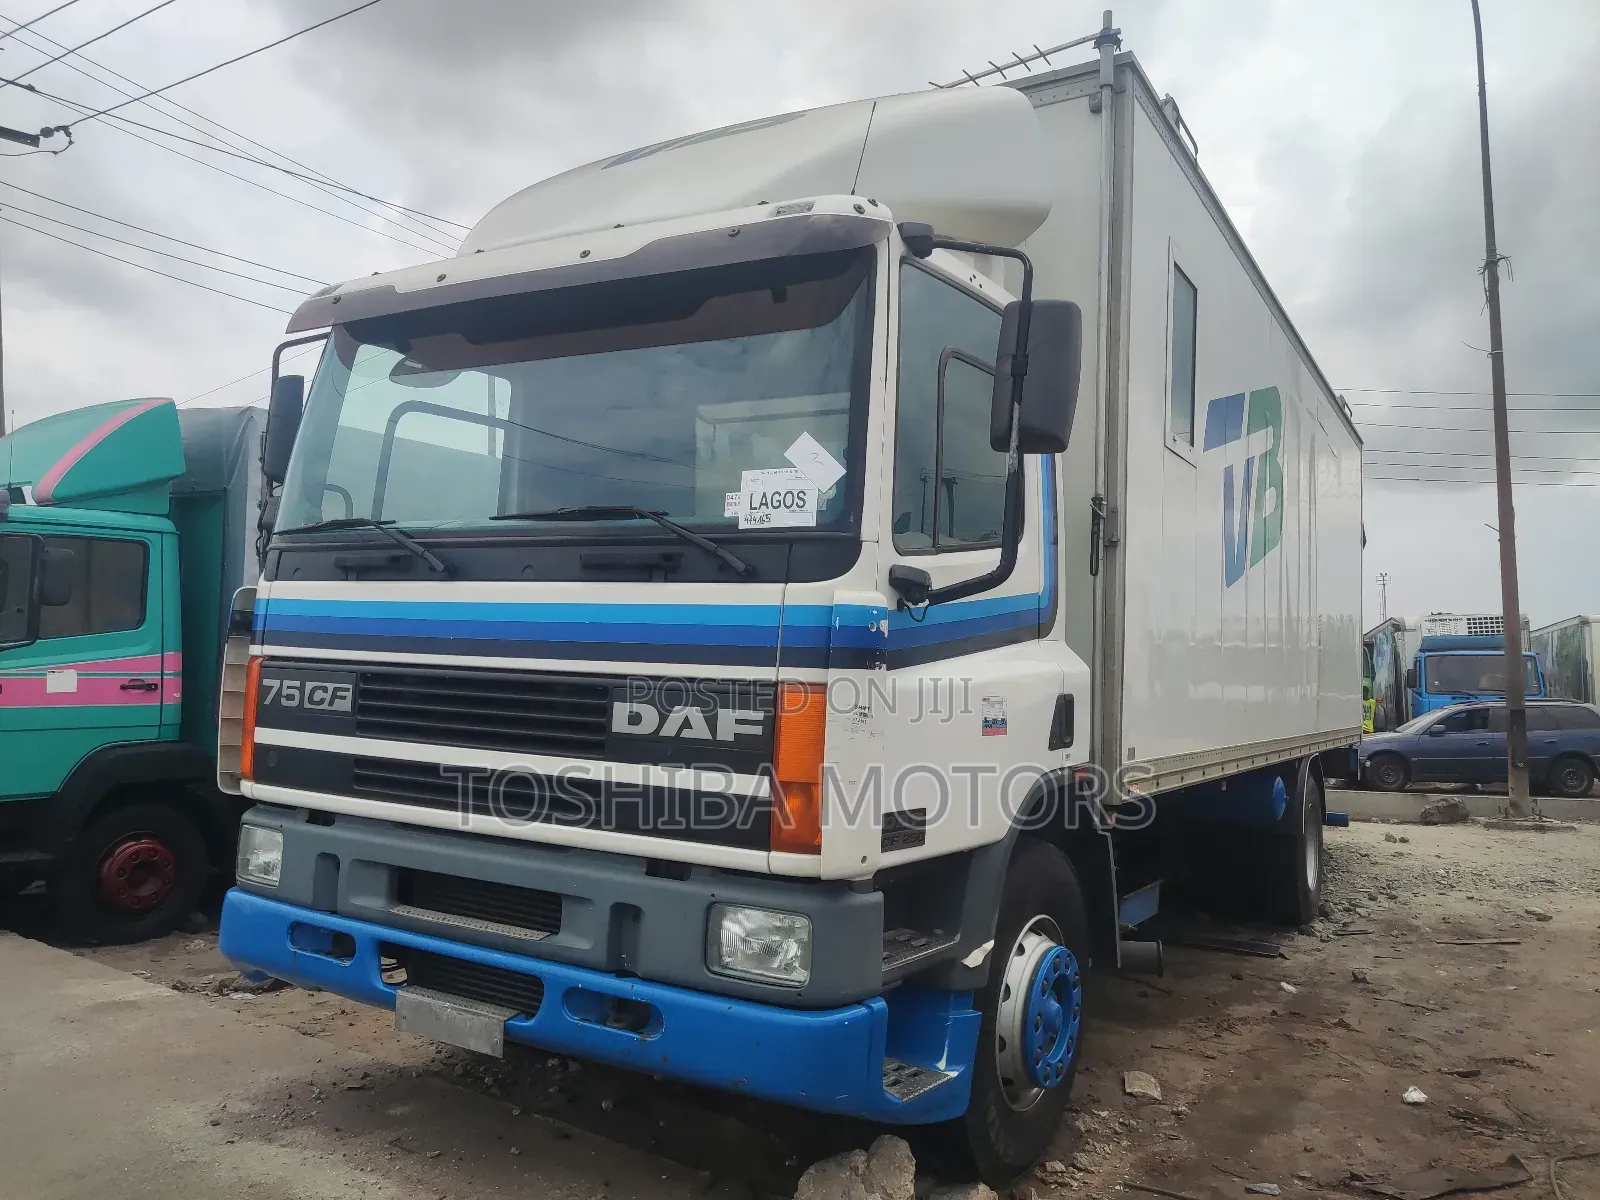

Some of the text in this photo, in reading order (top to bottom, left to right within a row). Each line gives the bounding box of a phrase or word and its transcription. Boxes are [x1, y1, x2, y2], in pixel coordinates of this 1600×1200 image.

[749, 490, 807, 511] LAGOS
[262, 678, 352, 708] 75 CF
[611, 701, 765, 742] DAF
